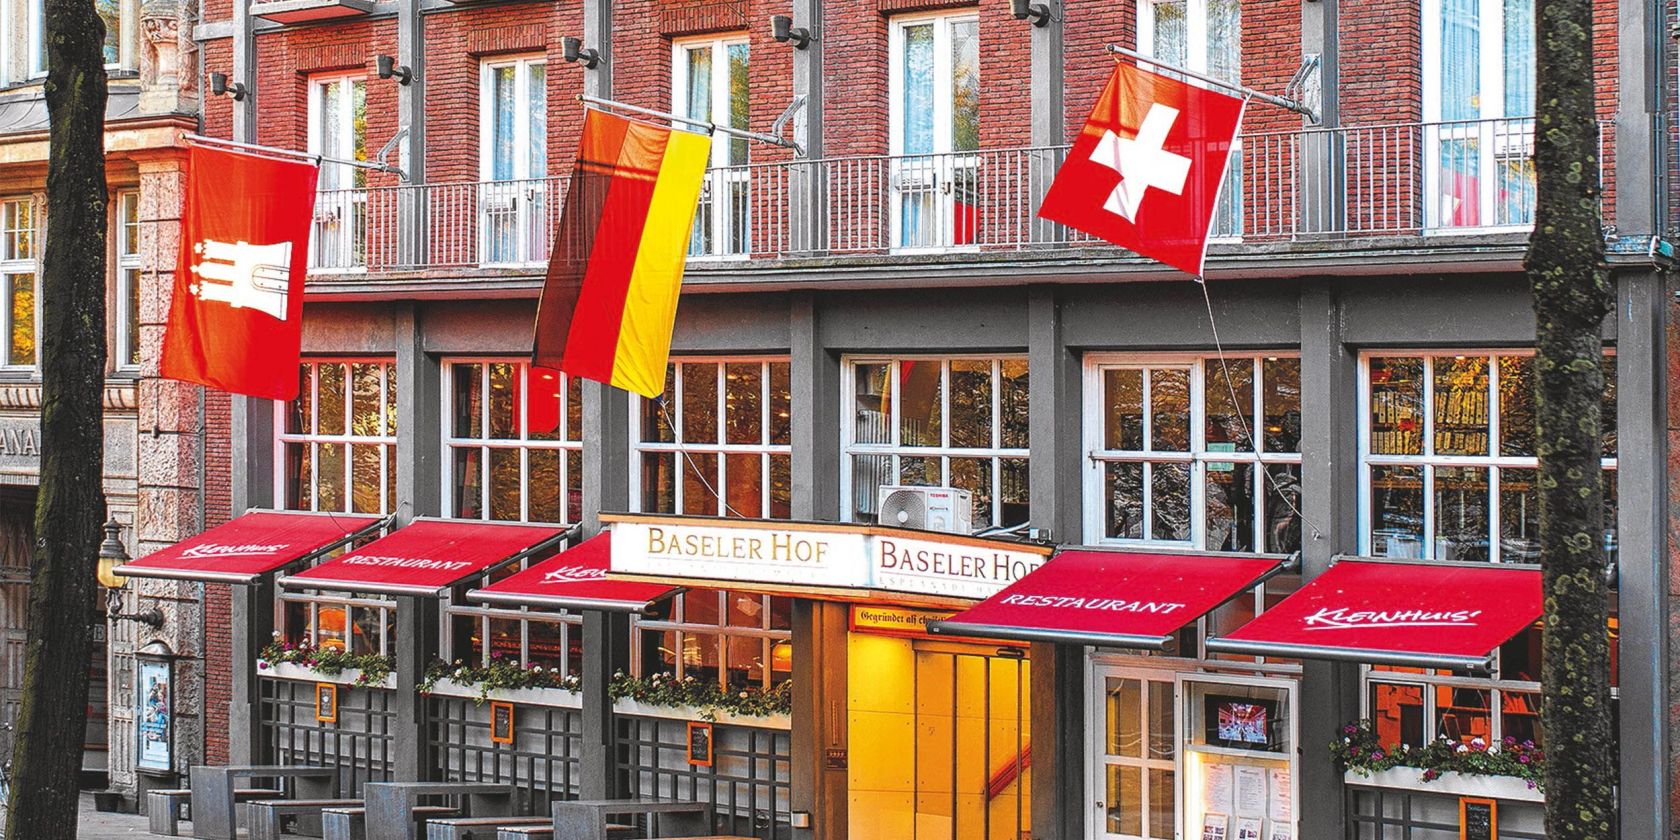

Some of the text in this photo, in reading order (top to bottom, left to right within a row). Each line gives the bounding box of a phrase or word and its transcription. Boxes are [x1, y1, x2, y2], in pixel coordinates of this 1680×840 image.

[648, 527, 829, 563] BASELER HOF
[342, 555, 473, 570] RESTAURANT
[880, 540, 986, 579] BASELER
[1001, 594, 1186, 614] RESTAURANT
